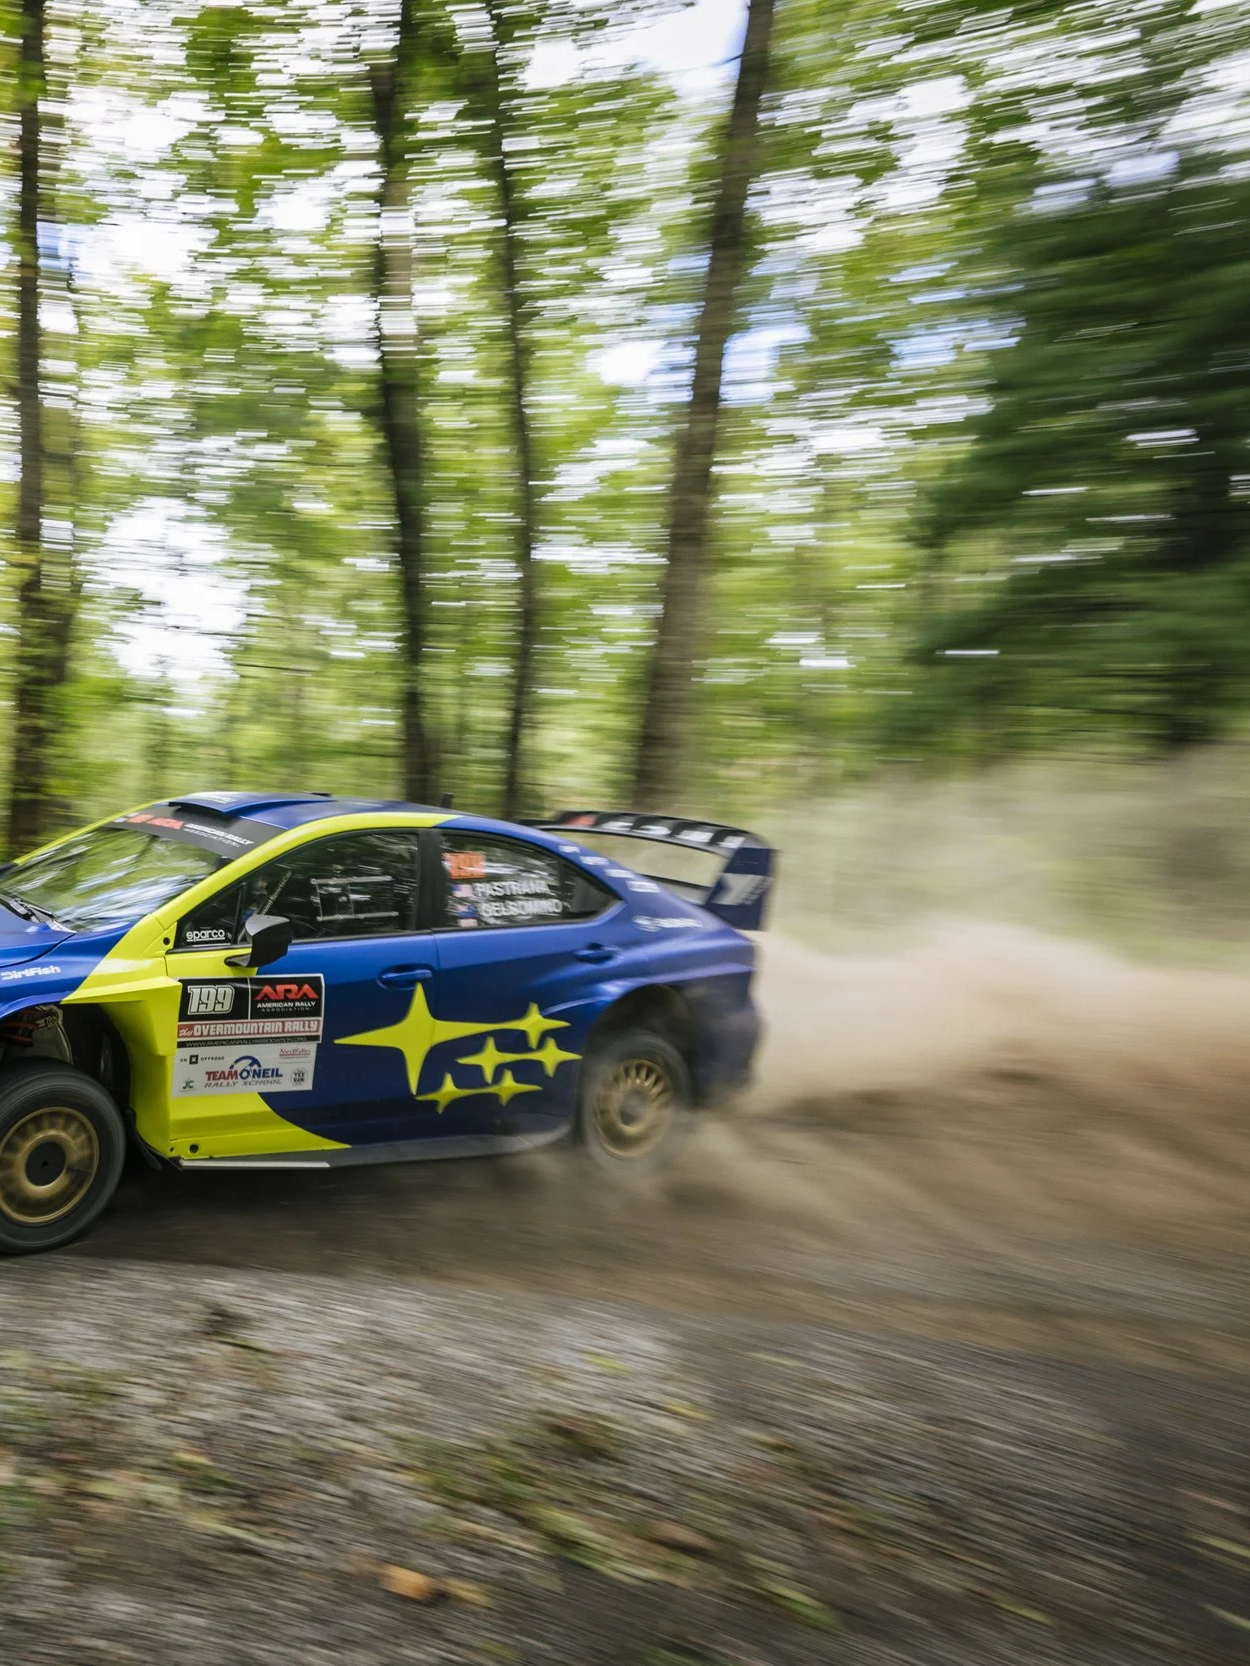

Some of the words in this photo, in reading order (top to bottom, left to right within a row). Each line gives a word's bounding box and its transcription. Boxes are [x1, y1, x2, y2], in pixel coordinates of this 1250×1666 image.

[186, 929, 225, 942] sparco
[0, 965, 62, 981] DirtFish
[254, 983, 319, 1000] ARA
[187, 985, 235, 1015] 199
[257, 1001, 293, 1009] AMERICAN
[179, 1027, 193, 1037] the
[193, 1022, 283, 1037] OVERMOUNTAIN
[285, 1020, 319, 1033] RALLY
[205, 1070, 238, 1082] TEAM
[204, 1081, 238, 1089] RALLY
[242, 1079, 282, 1087] SCHOOL
